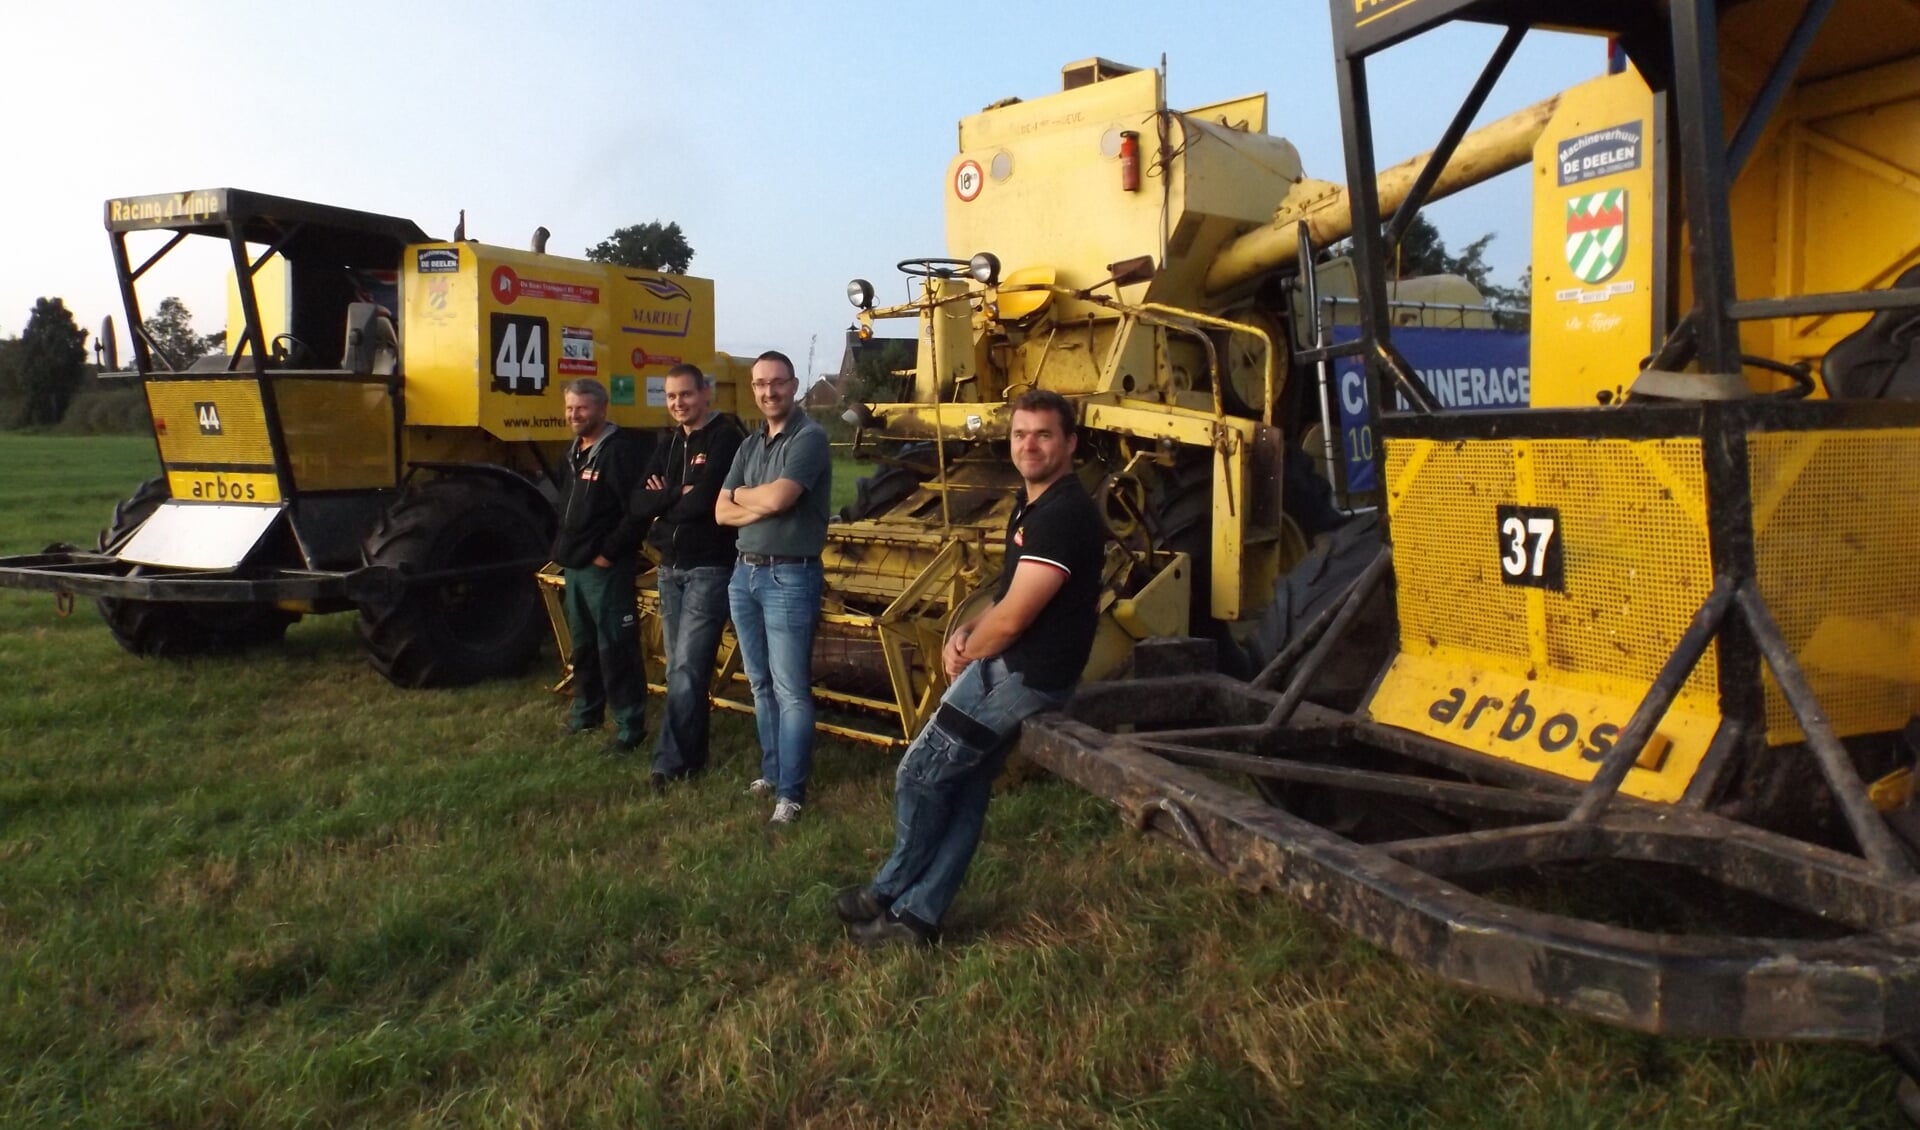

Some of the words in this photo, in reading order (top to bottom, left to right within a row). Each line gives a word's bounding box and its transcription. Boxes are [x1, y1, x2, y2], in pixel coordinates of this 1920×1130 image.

[1560, 128, 1640, 162] Machineverhuur
[1563, 160, 1580, 175] DE
[1583, 146, 1635, 170] DEELEN
[112, 200, 161, 224] Racing
[164, 199, 173, 221] 4
[632, 308, 681, 327] MARTEC
[496, 323, 544, 389] 44
[199, 405, 220, 429] 44
[192, 475, 256, 500] arbos
[1502, 517, 1555, 576] 37
[1428, 688, 1619, 764] arbos
